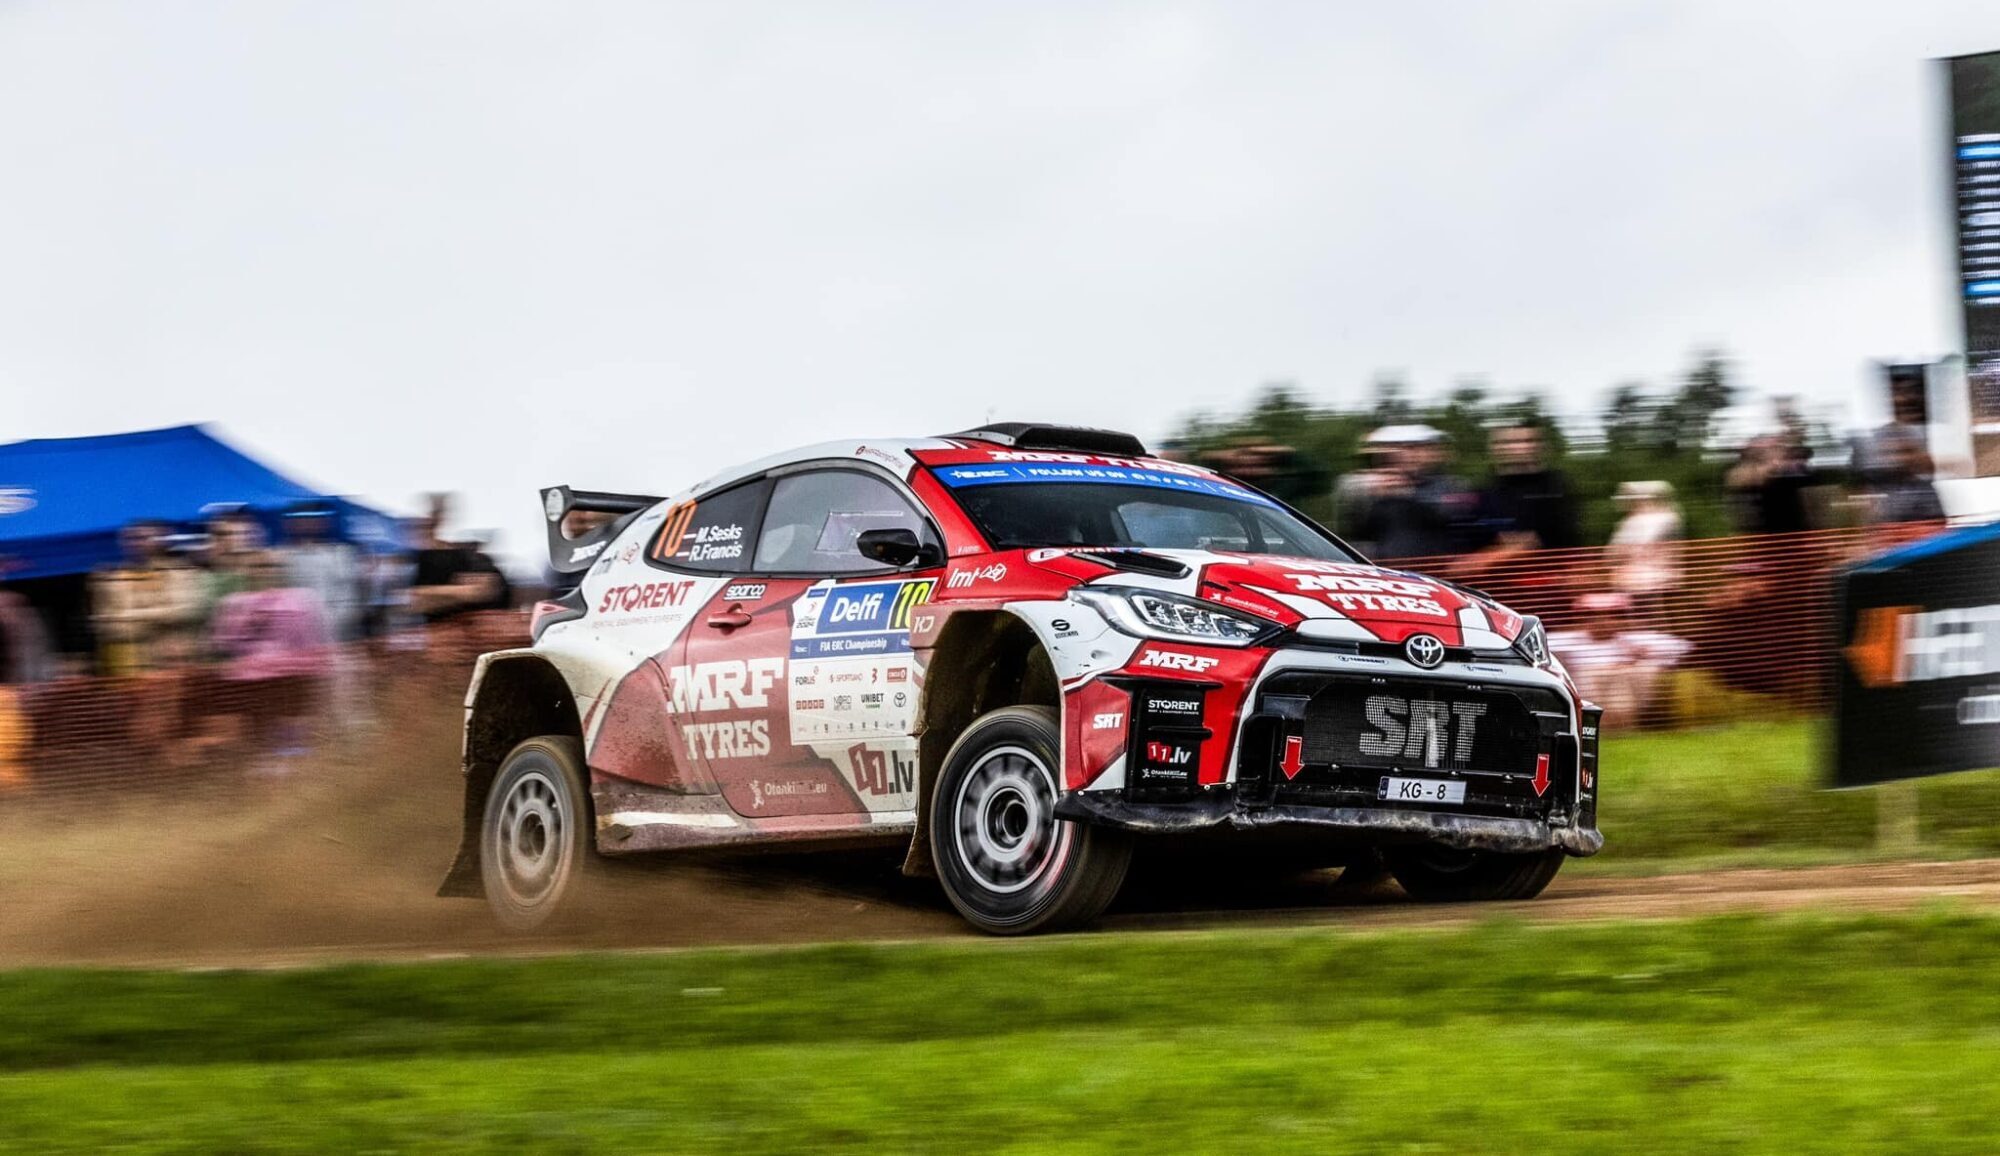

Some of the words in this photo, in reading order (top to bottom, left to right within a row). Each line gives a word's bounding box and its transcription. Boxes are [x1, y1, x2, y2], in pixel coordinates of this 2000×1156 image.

[652, 498, 698, 560] 10
[695, 523, 743, 543] M.Sesks
[688, 541, 743, 562] R.Francis
[947, 567, 980, 588] lmt
[1283, 574, 1440, 598] MRF
[598, 580, 695, 614] STORENT
[725, 584, 766, 600] sparco
[829, 593, 884, 623] Delfi
[895, 582, 930, 628] 10
[1326, 593, 1448, 617] TYRES
[820, 641, 831, 652] FIA
[832, 640, 844, 651] ERC
[845, 638, 887, 652] Championship
[1139, 650, 1219, 673] MRF
[667, 656, 784, 713] MRF
[861, 693, 884, 703] UNIBET
[1148, 699, 1200, 711] STORENT
[1093, 713, 1123, 729] SRT
[1359, 695, 1488, 762] SRT
[682, 719, 771, 760] TYRES
[1147, 741, 1192, 764] 11.lv
[847, 742, 914, 796] 11.lv
[1400, 781, 1422, 799] KG
[1436, 783, 1447, 800] 8
